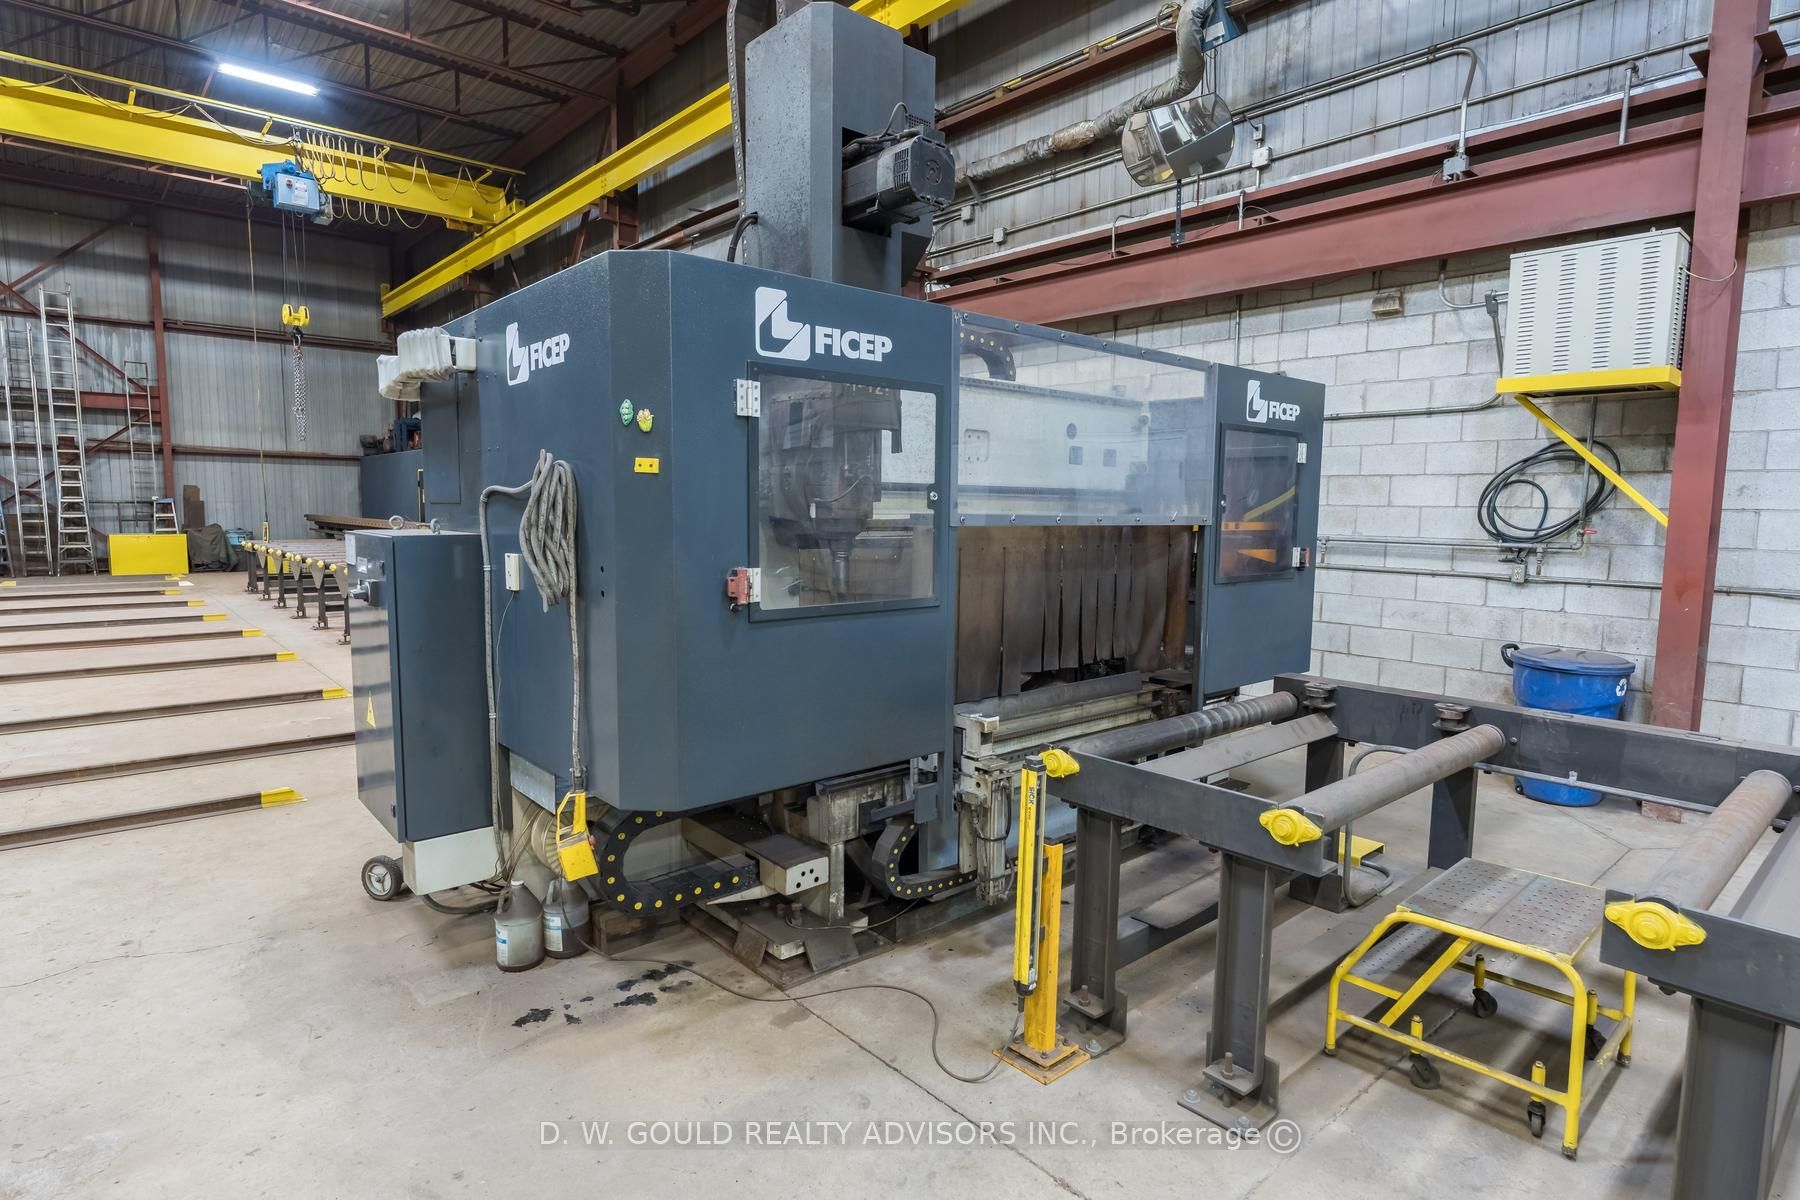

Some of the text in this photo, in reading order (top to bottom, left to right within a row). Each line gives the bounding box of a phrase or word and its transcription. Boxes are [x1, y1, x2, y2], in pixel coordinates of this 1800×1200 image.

[529, 333, 570, 371] FICEP
[815, 325, 893, 362] FICEP
[1269, 401, 1300, 421] FICEP
